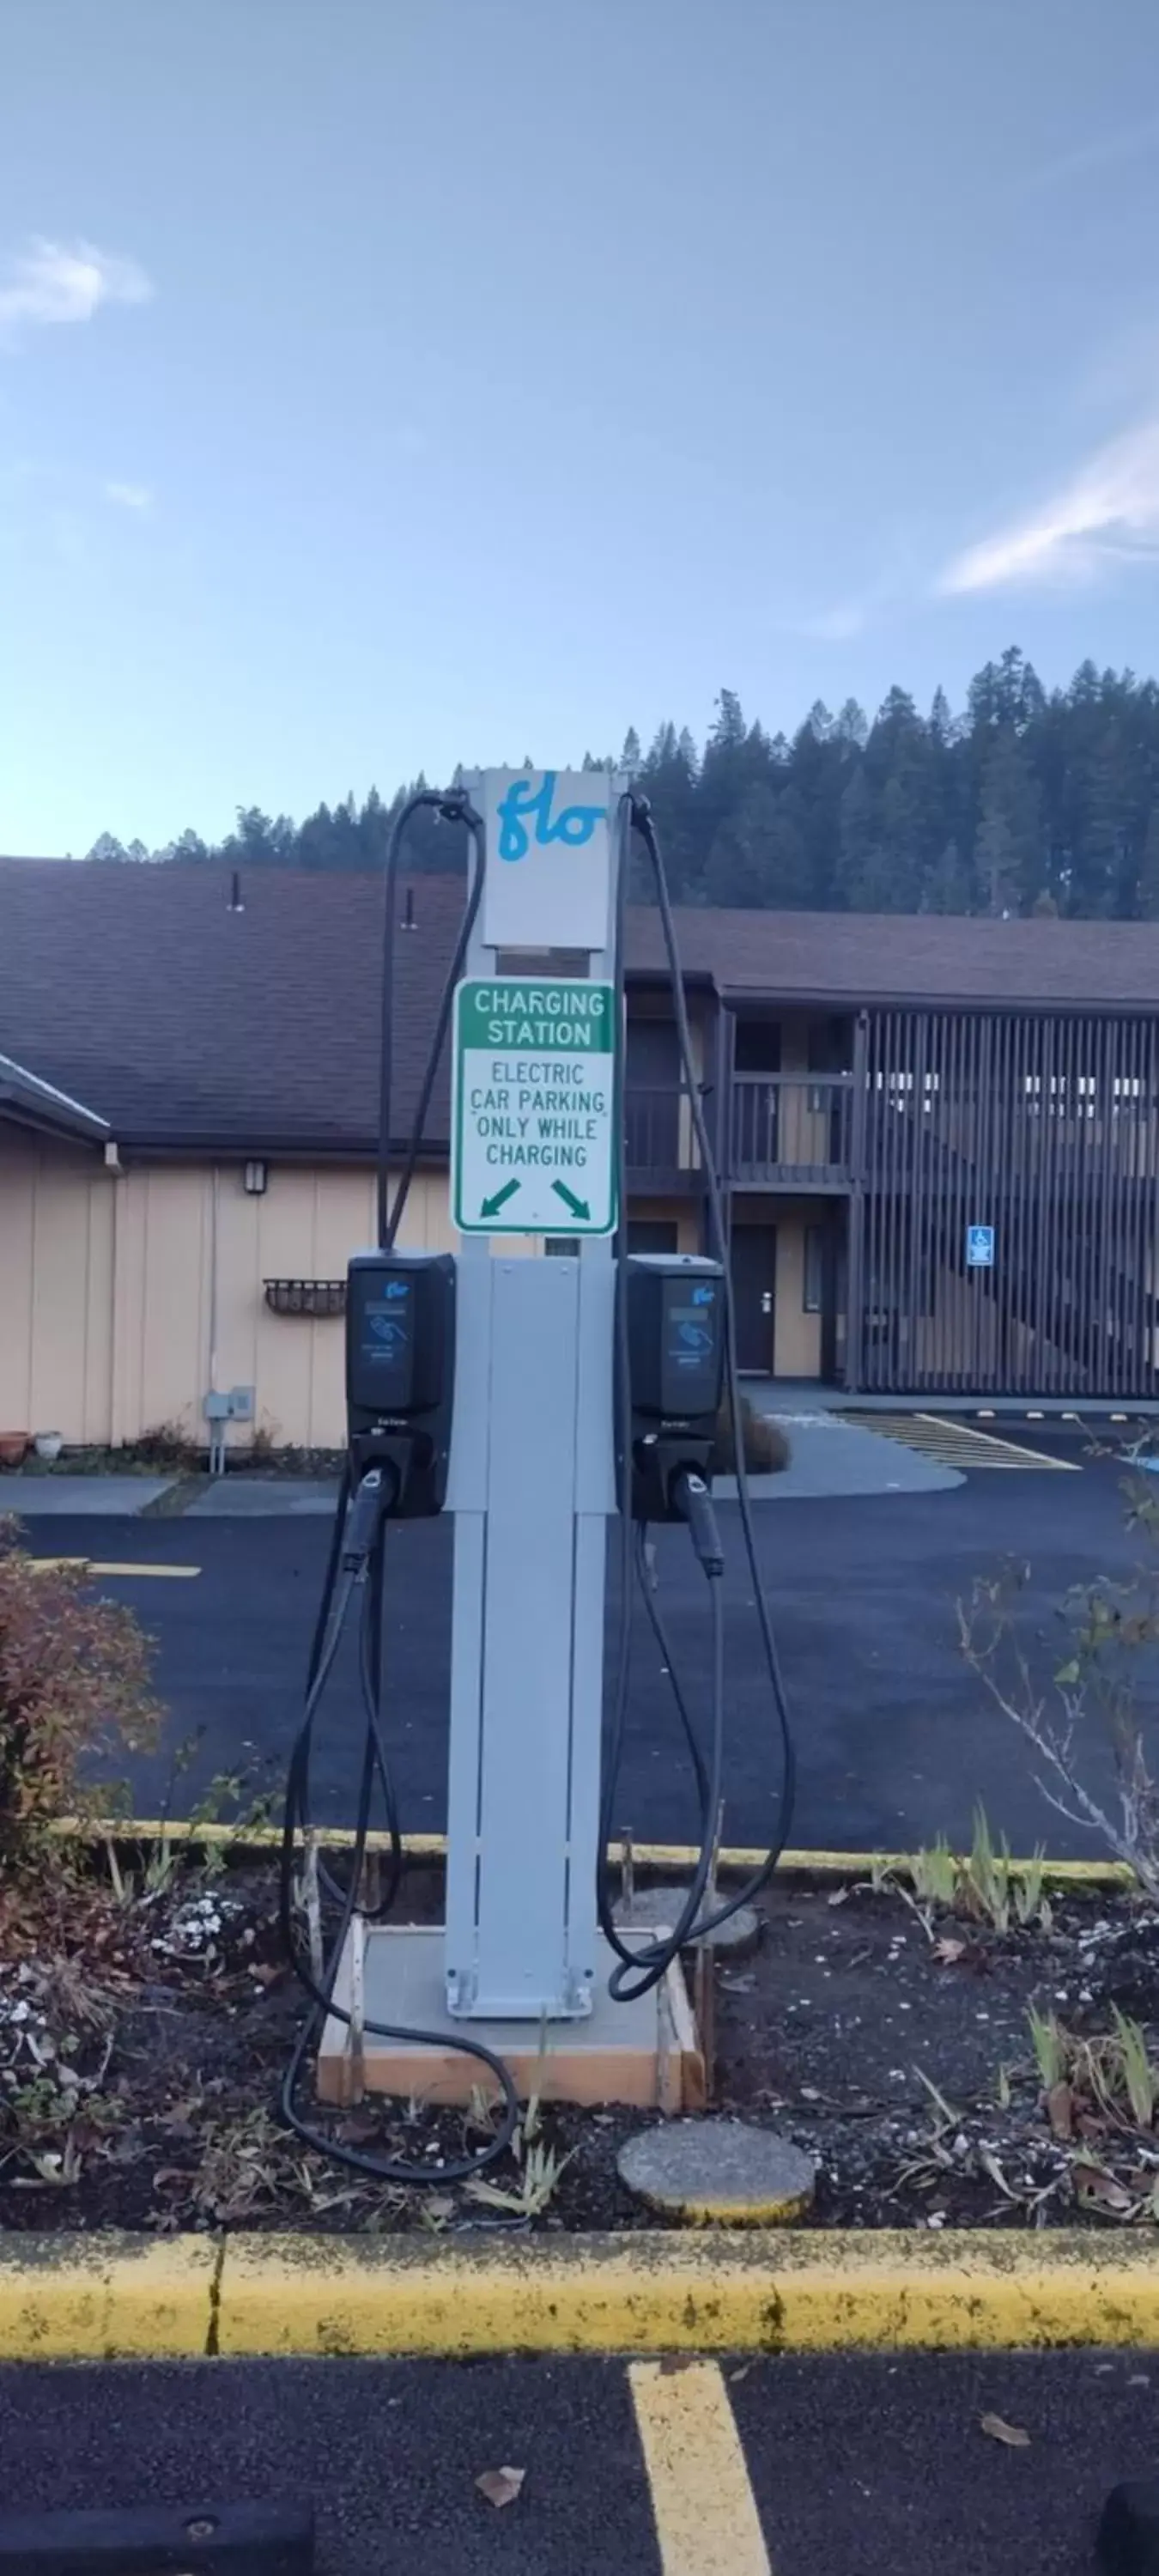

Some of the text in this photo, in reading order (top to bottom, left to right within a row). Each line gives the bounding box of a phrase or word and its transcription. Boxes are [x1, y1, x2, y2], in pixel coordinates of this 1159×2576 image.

[496, 771, 606, 861] flo
[474, 990, 605, 1017] CHARGING
[487, 1019, 592, 1046] STATION
[492, 1061, 584, 1084] ELECTRIC
[470, 1089, 605, 1113] CAR PARKING
[476, 1116, 598, 1140] ONLY WHILE
[486, 1144, 587, 1167] CHARGING
